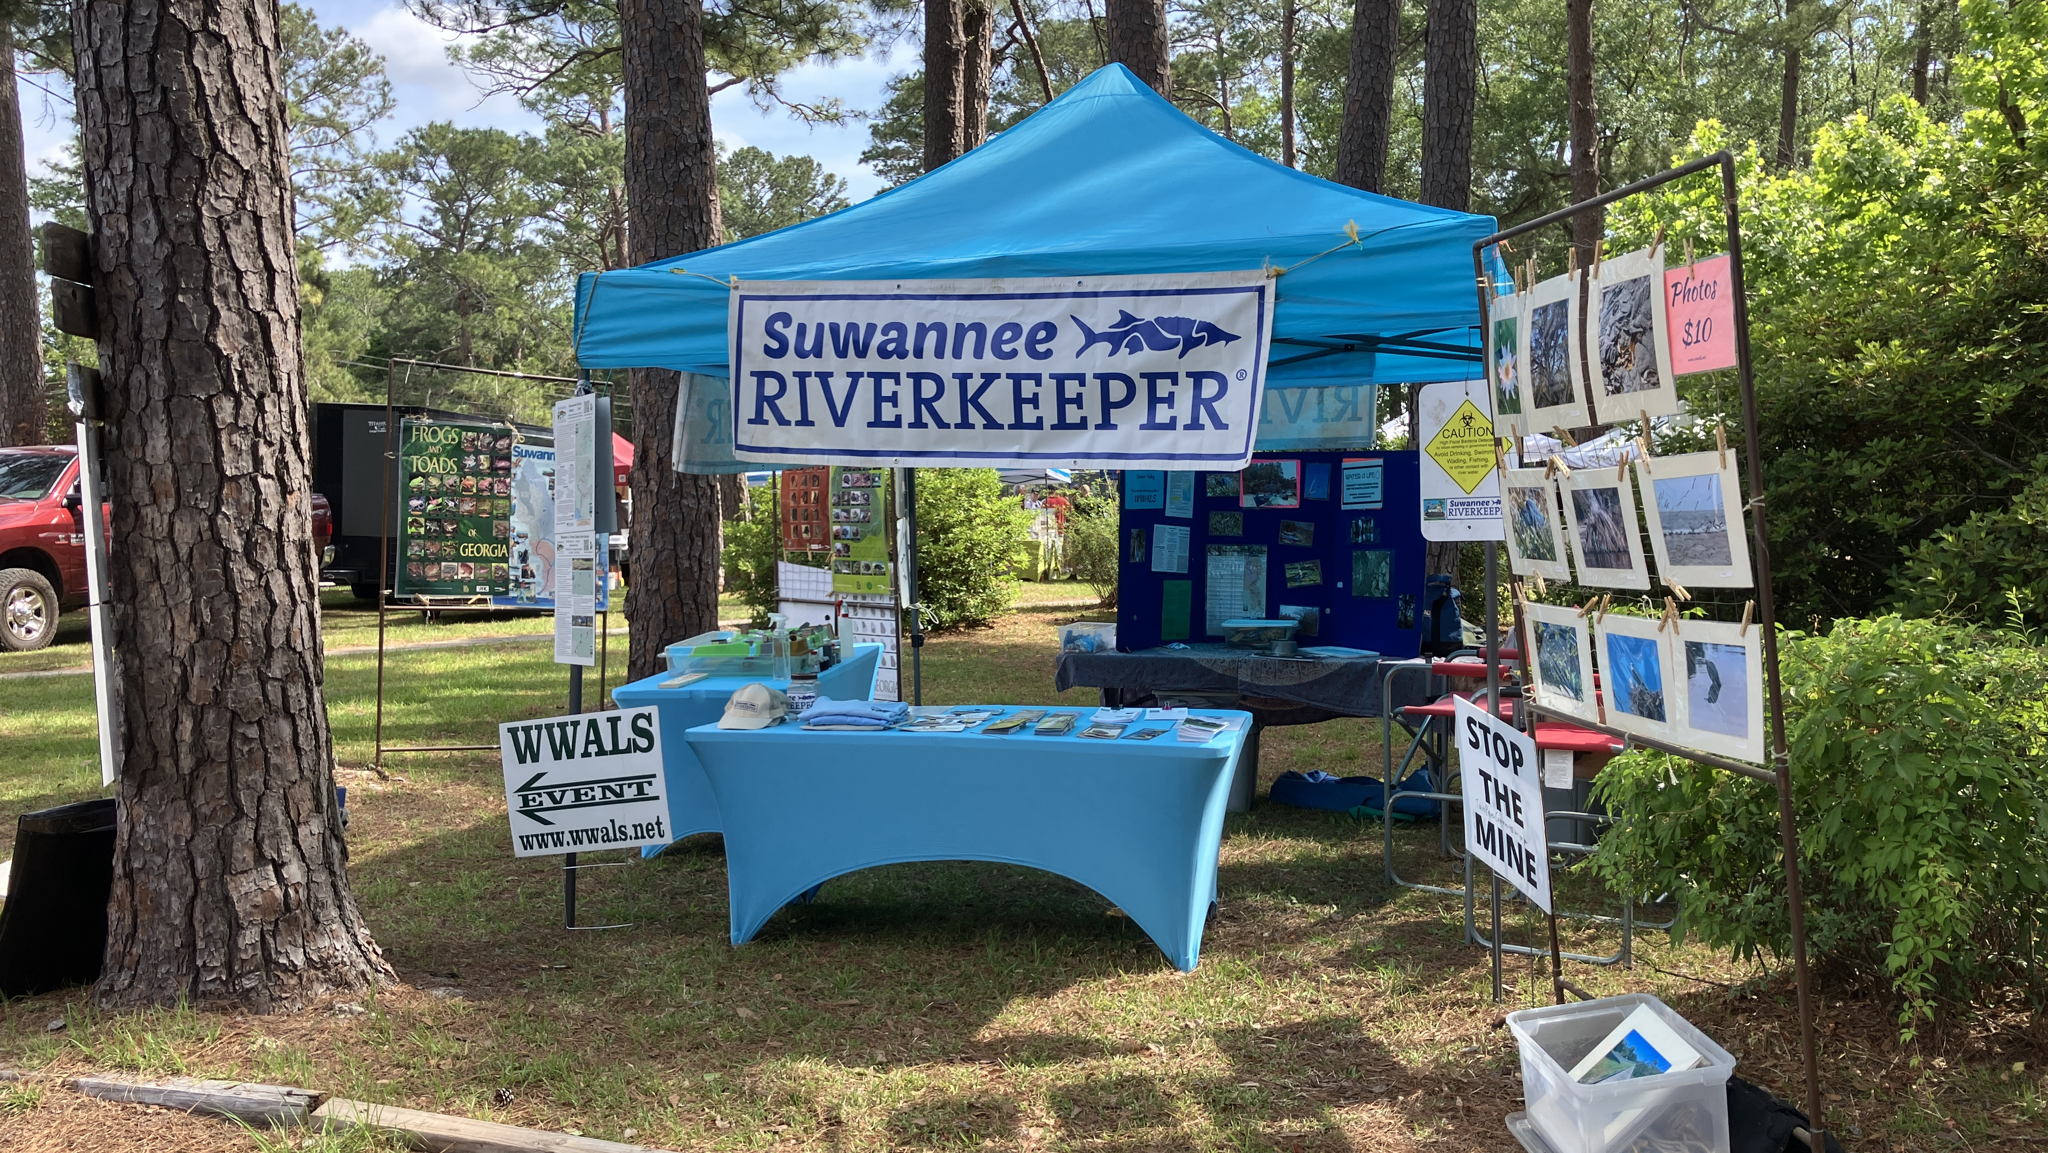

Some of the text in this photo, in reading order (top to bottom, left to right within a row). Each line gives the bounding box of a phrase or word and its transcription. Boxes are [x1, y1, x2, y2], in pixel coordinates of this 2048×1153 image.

[1671, 276, 1718, 308] Photos
[763, 311, 1058, 361] Suwannee
[1682, 317, 1713, 349] $10
[411, 426, 460, 444] FROGS
[1442, 426, 1493, 439] CAUTION
[428, 445, 443, 454] AND
[512, 445, 556, 461] Suwann
[410, 456, 458, 474] TOADS
[1448, 506, 1503, 517] RIVERKEEP
[1450, 499, 1490, 508] Suwannee
[468, 528, 477, 537] OF
[460, 542, 509, 558] GEORGIA
[507, 712, 655, 765] WWALS
[1466, 715, 1524, 777] STOP
[518, 780, 653, 809] EVENT
[1478, 767, 1525, 829] THE
[519, 815, 665, 851] www.wwals.net
[1475, 812, 1538, 889] MINE
